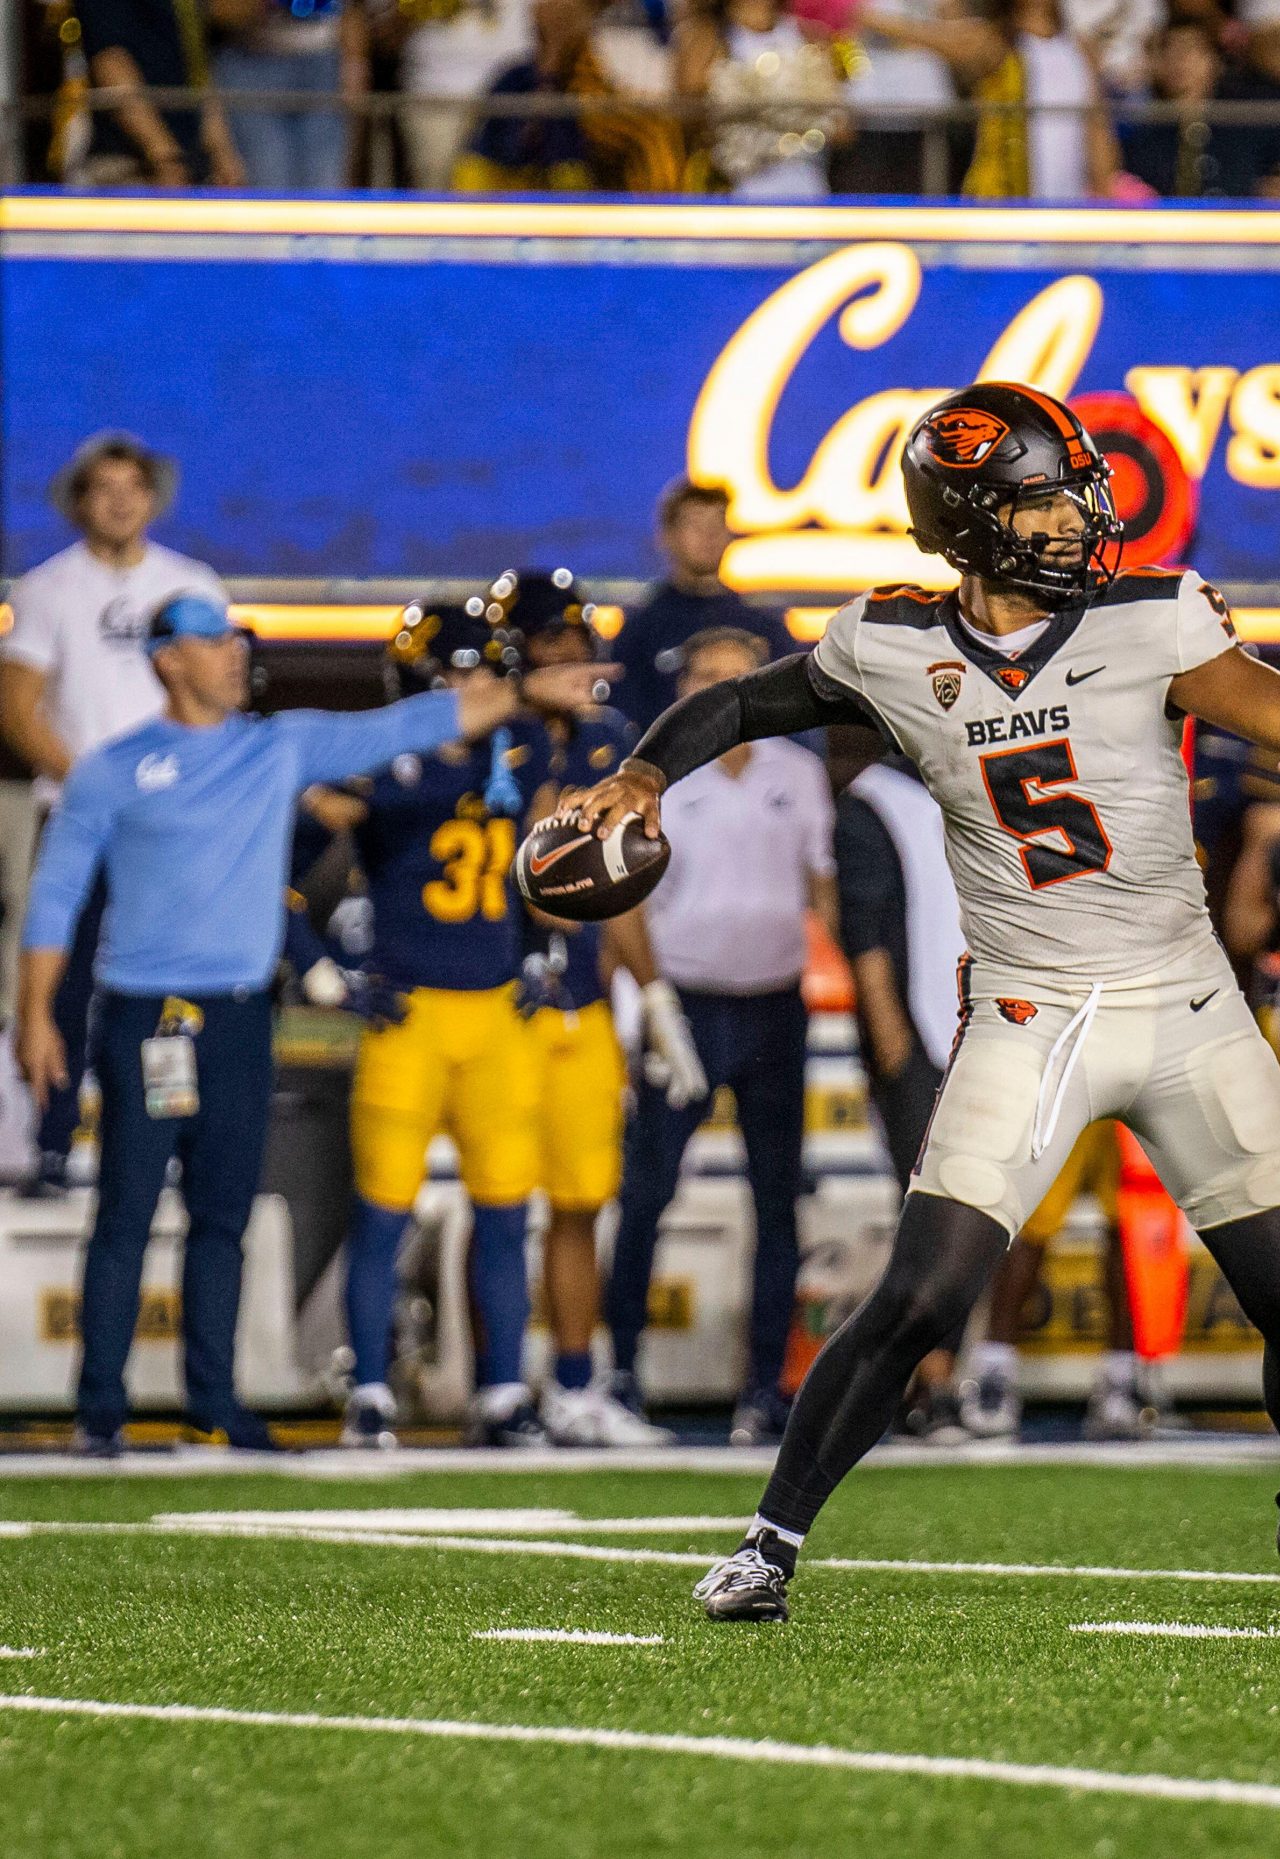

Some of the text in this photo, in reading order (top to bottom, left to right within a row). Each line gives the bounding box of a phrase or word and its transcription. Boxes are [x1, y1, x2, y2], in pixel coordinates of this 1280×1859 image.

[1070, 452, 1092, 469] OSU
[941, 688, 954, 703] 12
[964, 704, 1071, 747] BEAVS
[978, 738, 1113, 890] 5
[421, 818, 516, 923] 31
